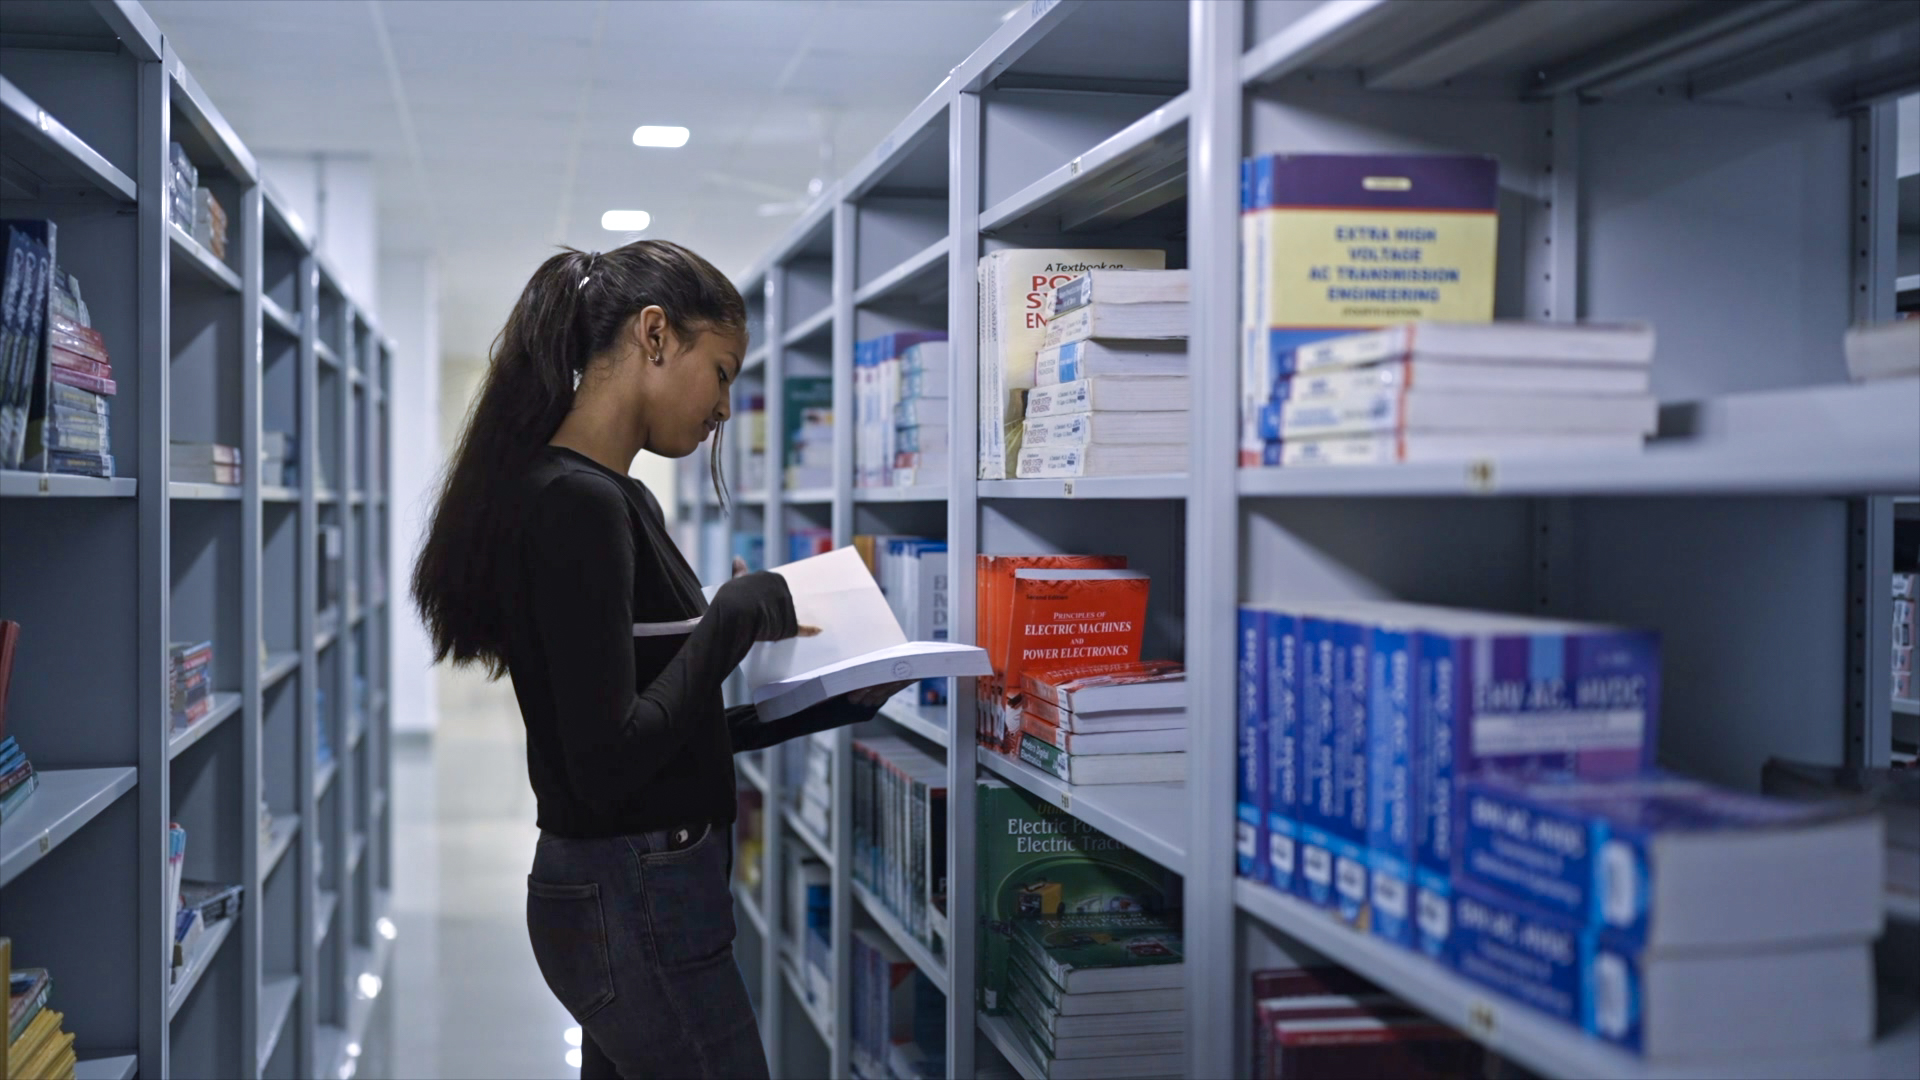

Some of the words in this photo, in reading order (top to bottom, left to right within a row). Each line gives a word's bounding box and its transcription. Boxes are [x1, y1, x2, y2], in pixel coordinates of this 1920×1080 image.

[1335, 227, 1389, 241] EXTRA
[1395, 228, 1437, 241] HIGH
[1348, 248, 1422, 261] VOLTAGE
[1045, 262, 1053, 272] A
[1056, 262, 1108, 272] Textbook
[1309, 267, 1330, 280] AC
[1337, 267, 1460, 281] TRANSMISSION
[1327, 287, 1440, 302] ENGINEERING
[1024, 624, 1076, 635] ELECTRIC
[1078, 622, 1132, 634] MACHINES
[1023, 648, 1059, 660] POWER
[1060, 645, 1129, 659] ELECTRONICS
[1008, 818, 1068, 834] Electric
[1017, 837, 1076, 853] Electric
